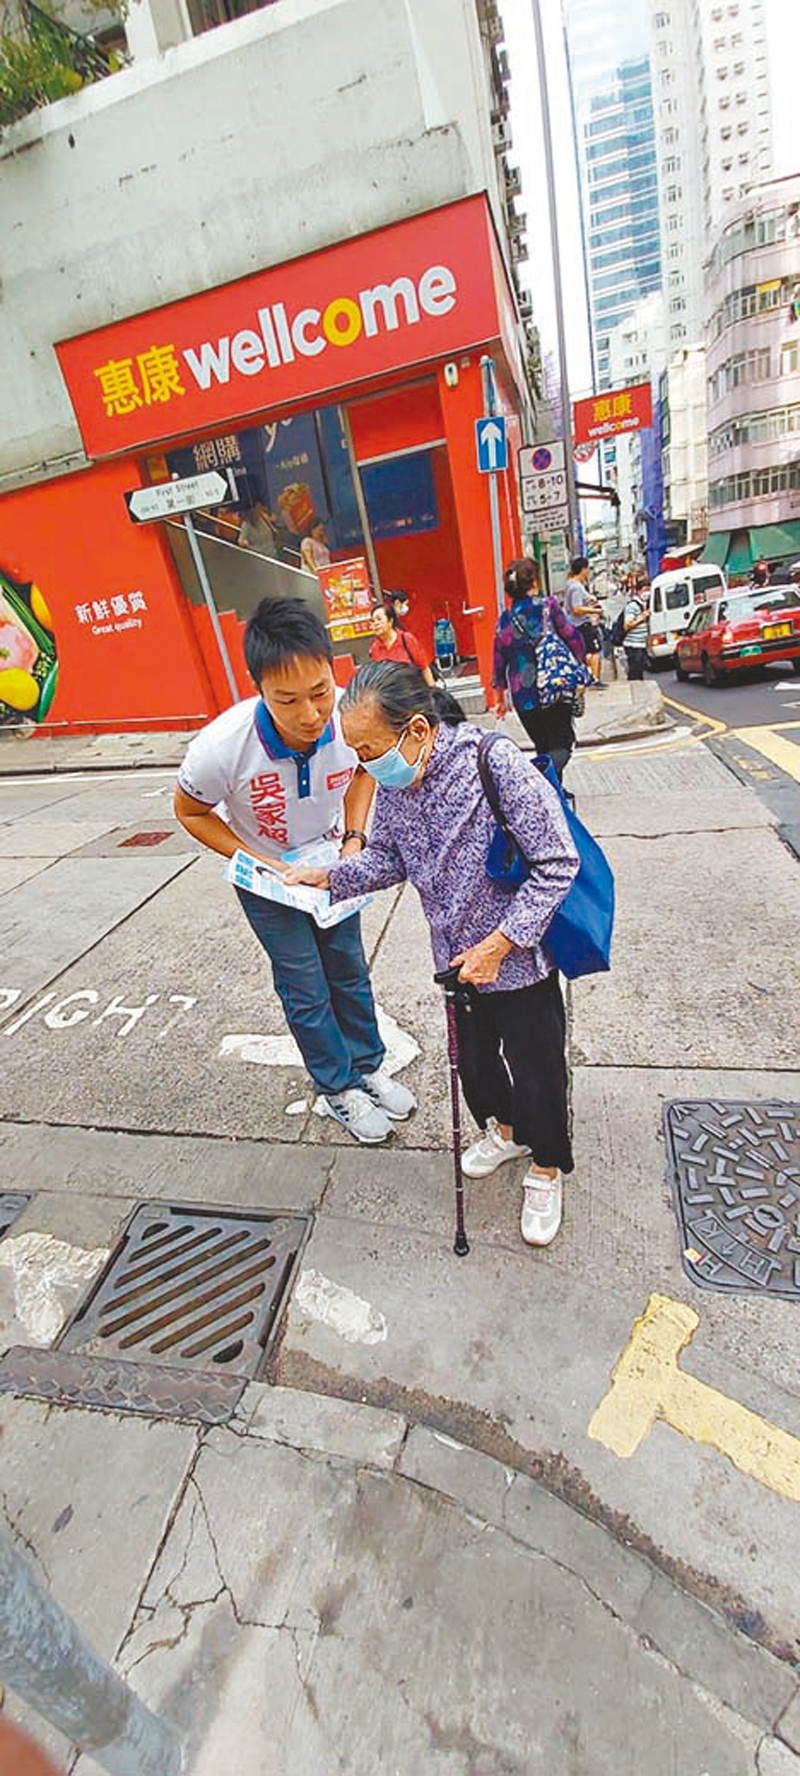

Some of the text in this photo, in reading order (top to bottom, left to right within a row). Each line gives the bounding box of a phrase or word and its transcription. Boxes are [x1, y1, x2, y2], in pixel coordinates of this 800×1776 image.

[183, 265, 457, 390] wellcome
[94, 344, 186, 418] 惠康
[592, 392, 632, 422] 惠康
[588, 417, 640, 437] wellcome
[75, 590, 148, 623] 新鮮優質
[92, 618, 142, 636] Great quality
